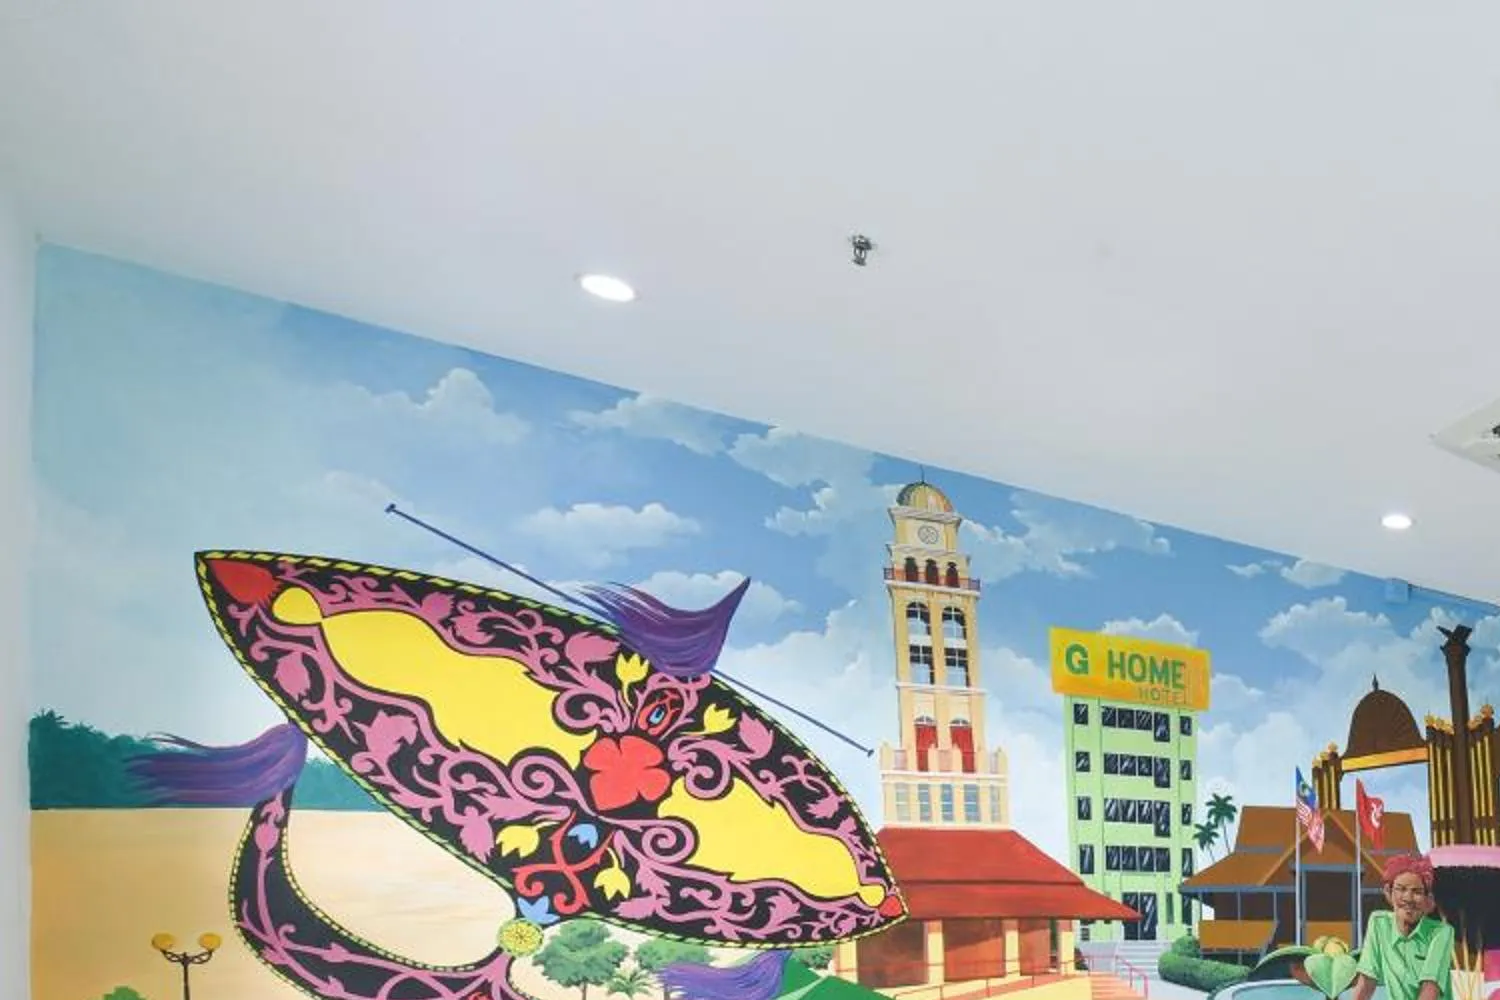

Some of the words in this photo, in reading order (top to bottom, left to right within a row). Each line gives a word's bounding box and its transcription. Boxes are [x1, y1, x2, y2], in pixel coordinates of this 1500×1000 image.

[1065, 643, 1089, 675] G
[1107, 649, 1186, 690] HOME
[1138, 687, 1190, 705] HOTEL
